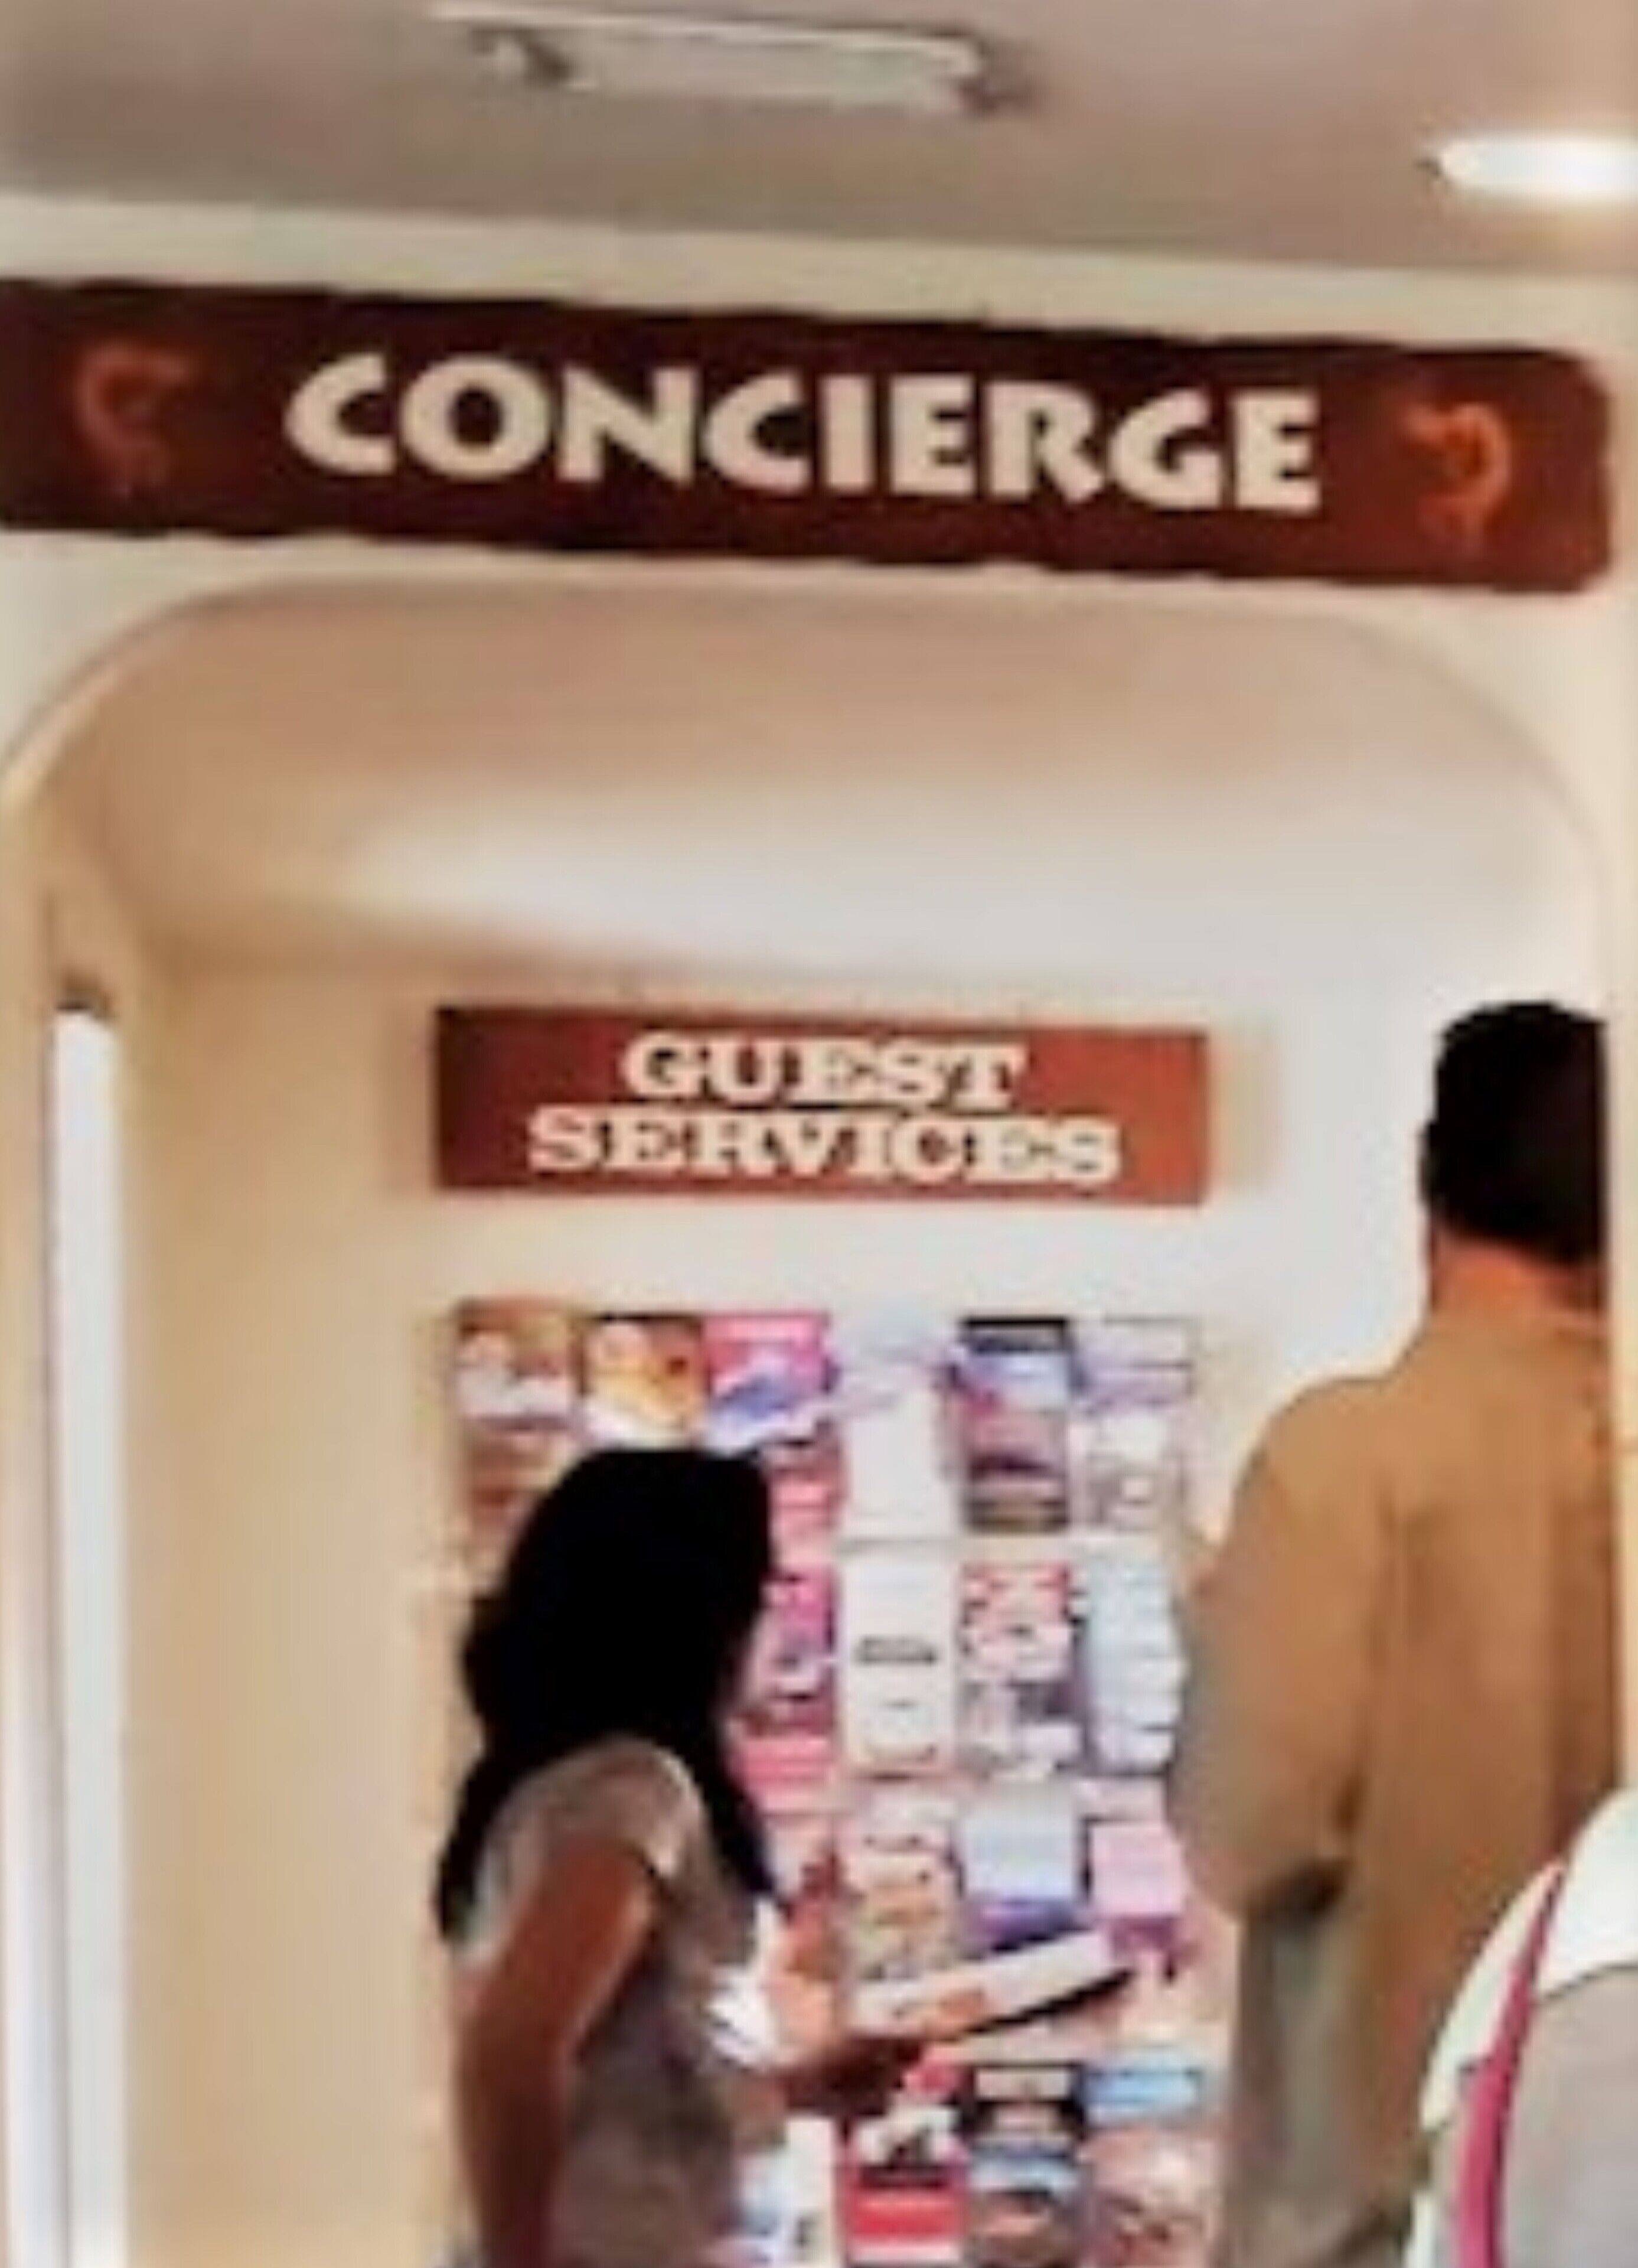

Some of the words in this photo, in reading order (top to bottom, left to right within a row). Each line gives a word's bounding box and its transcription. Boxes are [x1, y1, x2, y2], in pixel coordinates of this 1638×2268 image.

[287, 353, 1320, 511] CONCIERGE
[621, 1031, 1027, 1106] GUEST
[527, 1105, 1123, 1184] SERVICES
